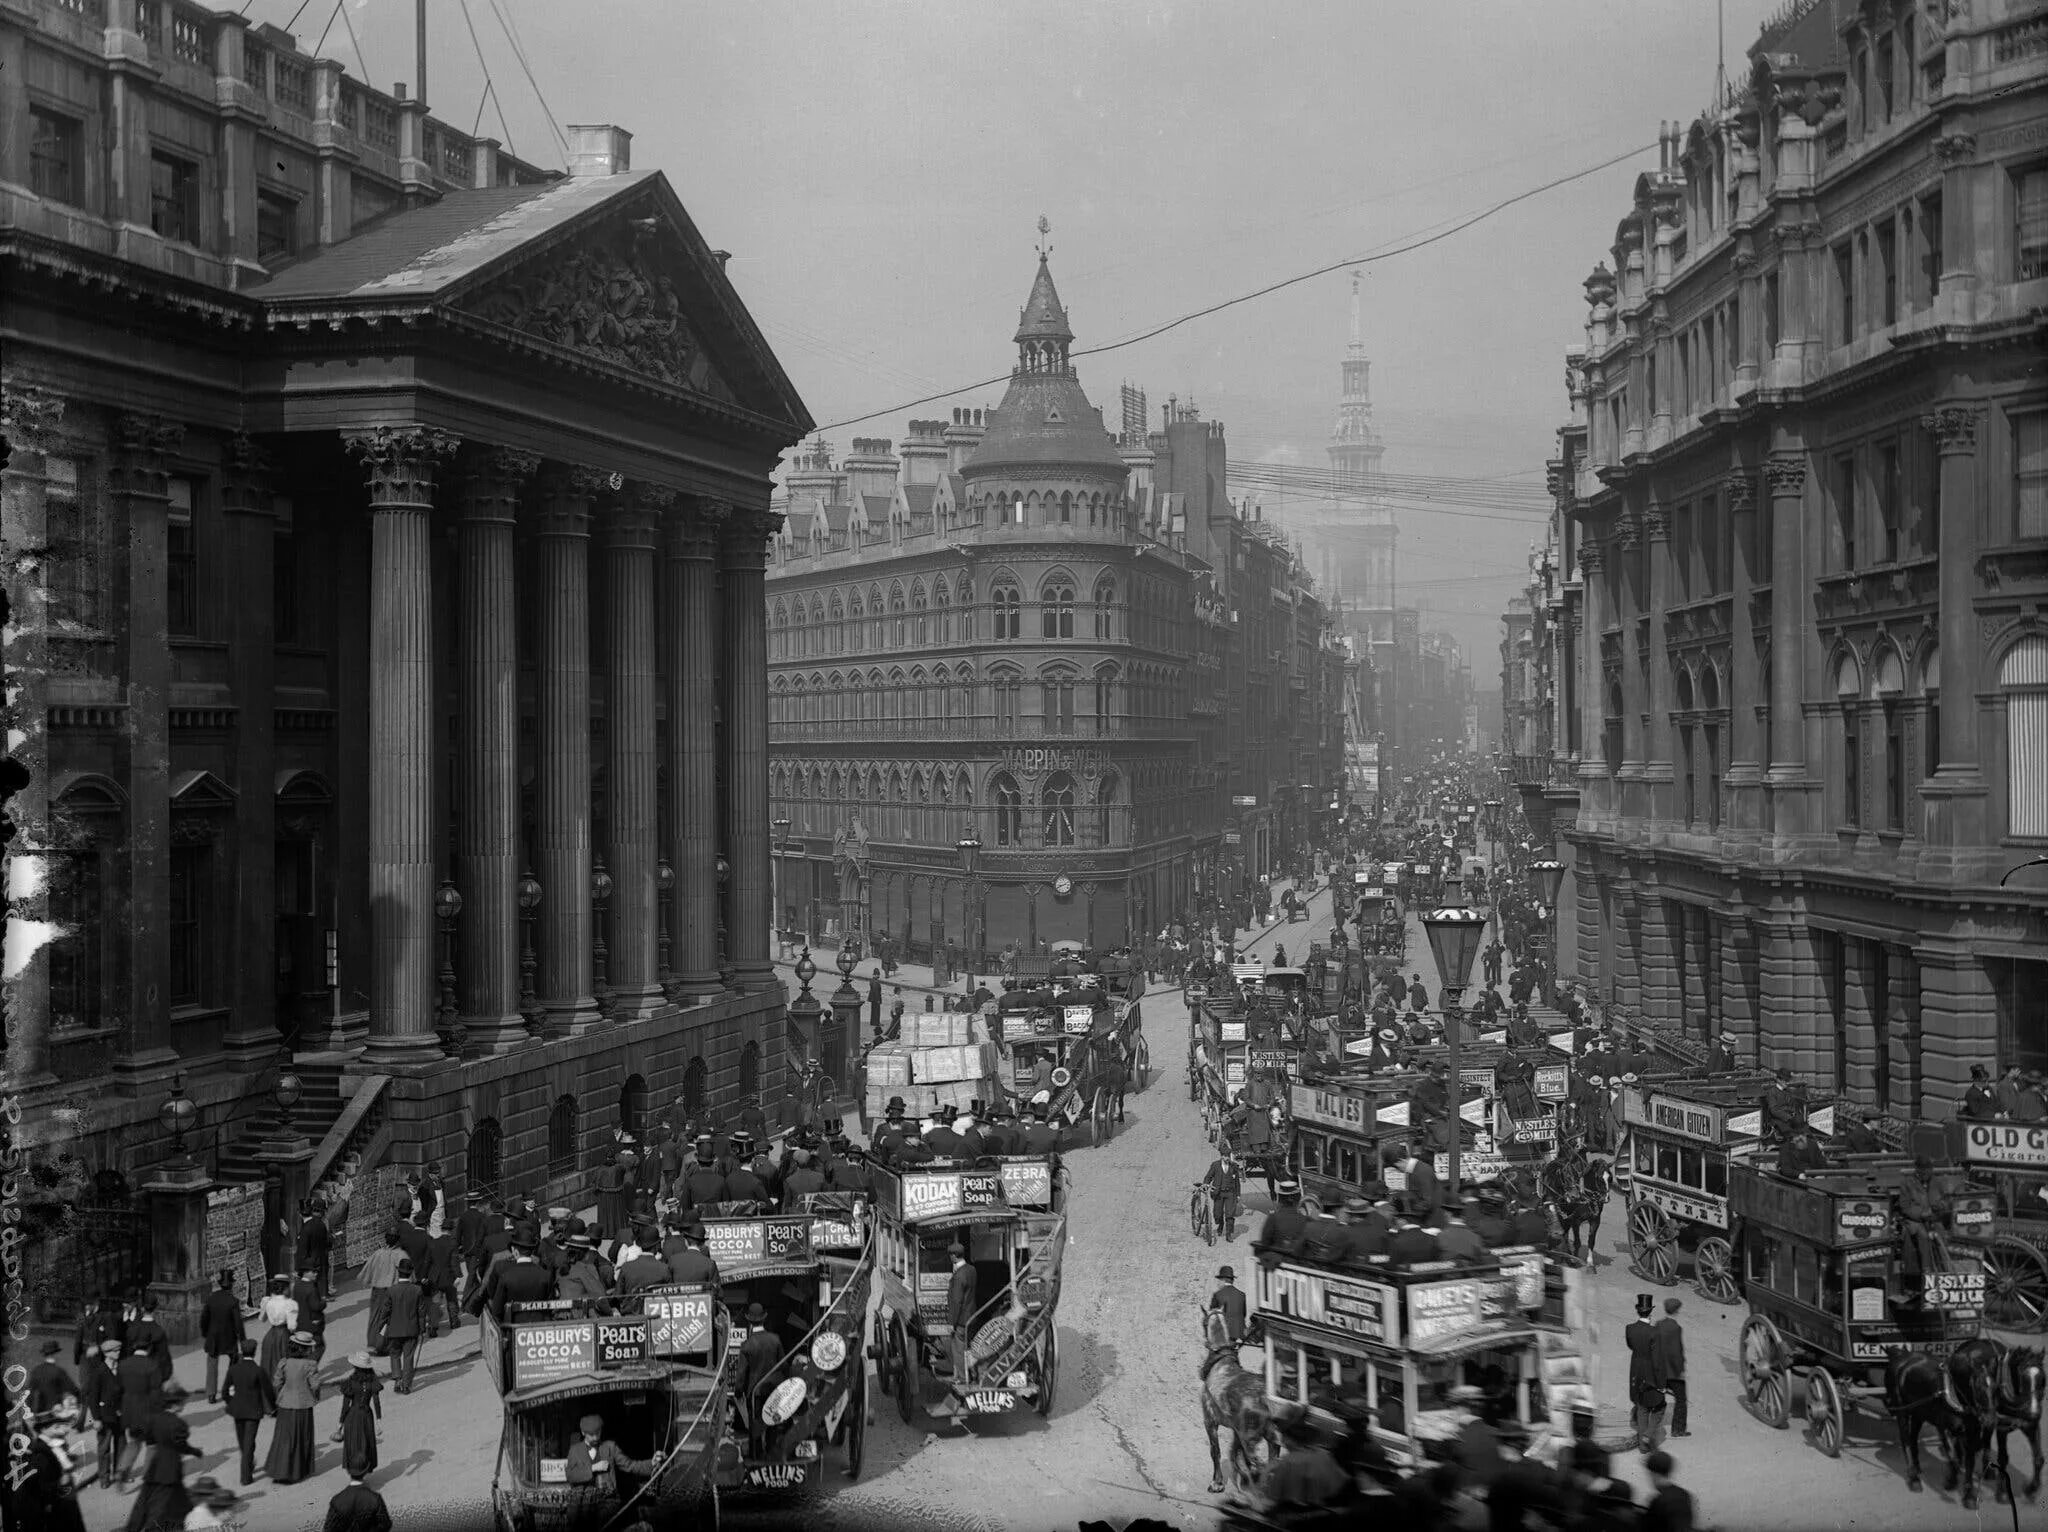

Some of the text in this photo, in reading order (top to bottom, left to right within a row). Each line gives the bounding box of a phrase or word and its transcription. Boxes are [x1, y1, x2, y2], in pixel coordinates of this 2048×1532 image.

[1001, 749, 1060, 771] MAPPIN
[1266, 1060, 1287, 1068] MILK
[1655, 1102, 1685, 1132] AMERICAN
[1686, 1110, 1711, 1138] CITIZEN
[1533, 1130, 1557, 1140] MILK
[1971, 1126, 2020, 1149] OLD
[1003, 1166, 1049, 1180] ZEBRA
[904, 1180, 960, 1206] KODAK
[963, 1191, 993, 1205] Soap
[946, 1216, 988, 1229] CHARING
[1841, 1213, 1885, 1227] HUDSON'S
[709, 1239, 754, 1250] COCOA
[811, 1233, 861, 1246] POLISH
[770, 1241, 786, 1253] So
[733, 1267, 782, 1282] TOTTENHAM
[1949, 1289, 1985, 1303] MILK
[648, 1301, 709, 1319] ZEBRA
[651, 1318, 678, 1346] Grate
[527, 1344, 583, 1359] COCOA
[570, 1361, 592, 1370] BEST
[524, 1380, 656, 1408] TOWER BRIDGE BURDETT
[978, 1404, 1000, 1413] FOOD
[765, 1480, 789, 1488] FOOD
